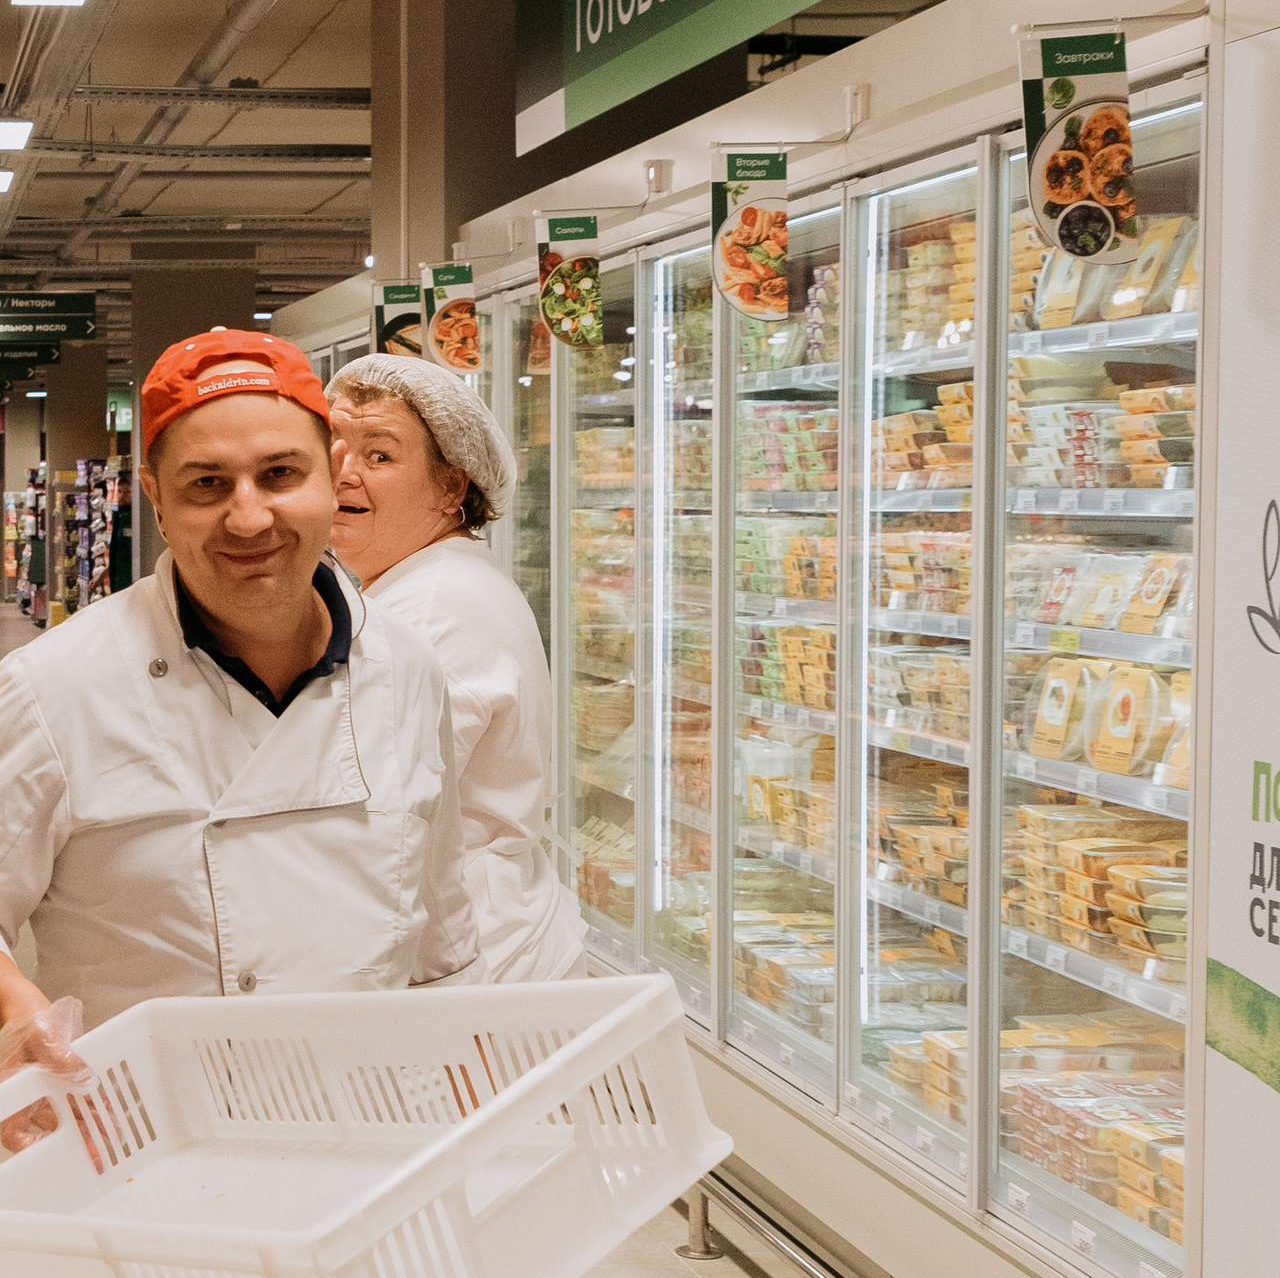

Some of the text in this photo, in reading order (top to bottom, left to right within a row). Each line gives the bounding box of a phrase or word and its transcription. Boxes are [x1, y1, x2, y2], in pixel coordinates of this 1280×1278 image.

[1055, 49, 1114, 65] Завтраки
[735, 157, 770, 168] Вторые
[735, 168, 767, 178] блюда
[555, 226, 585, 235] Салаты
[36, 323, 67, 332] масло
[197, 377, 270, 396] backaldrin.com
